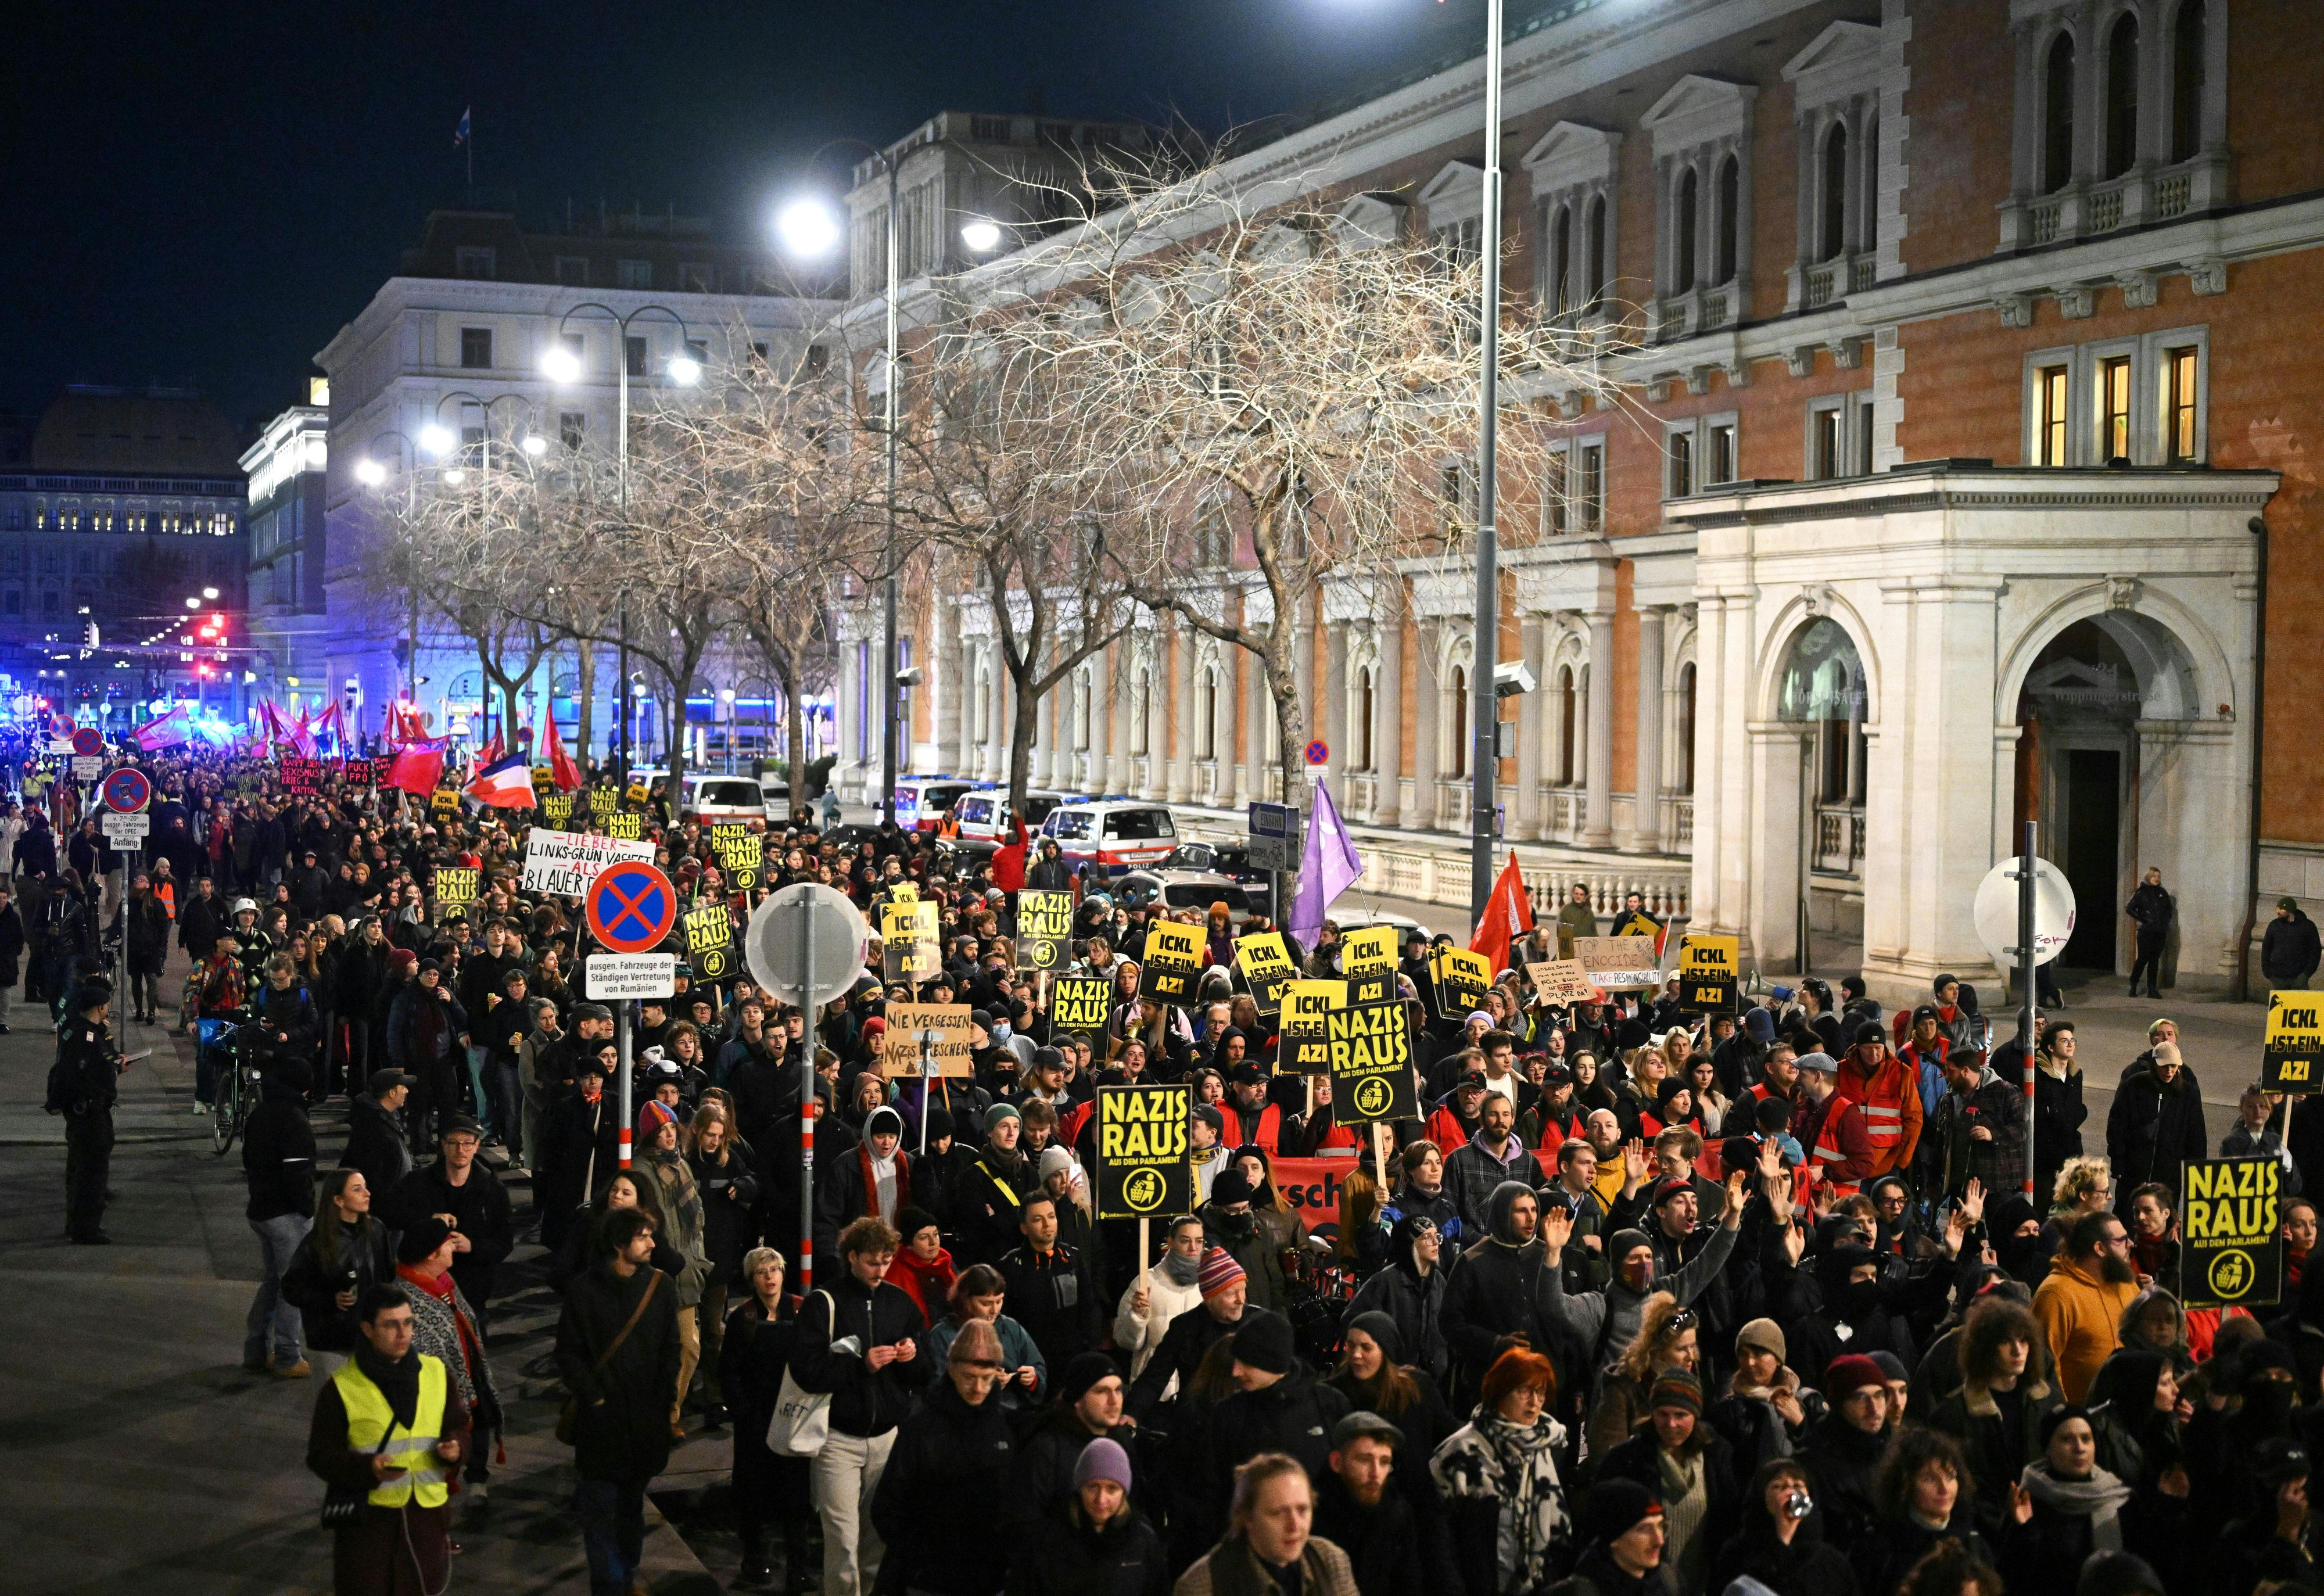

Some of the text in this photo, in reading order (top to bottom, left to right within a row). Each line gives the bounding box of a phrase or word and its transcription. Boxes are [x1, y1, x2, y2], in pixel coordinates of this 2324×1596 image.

[281, 768, 319, 777] SEXISMUS
[349, 763, 368, 772] FUCK
[282, 776, 300, 784] KRIEG
[291, 786, 318, 795] KAPITAL
[591, 790, 617, 801] NAZIS
[545, 795, 572, 806] NAZIS
[590, 801, 616, 812] RAUS
[546, 806, 572, 817] RAUS
[609, 813, 640, 826] NAZIS
[1261, 815, 1282, 829] EINBAHN
[609, 825, 640, 838] RAUS
[712, 825, 745, 837] NAZIS
[568, 833, 616, 851] LIEBER
[725, 836, 760, 853] NAZIS
[530, 842, 602, 863] LINKS-GRÜN
[727, 849, 761, 867] RAUS
[437, 870, 476, 884] NAZIS
[572, 862, 600, 876] ALS
[525, 869, 583, 894] BLAUER
[437, 884, 476, 899] RAUS
[1021, 894, 1071, 913] NAZIS
[685, 905, 727, 931] NAZIS
[895, 915, 928, 931] ICKL
[1020, 912, 1070, 934] RAUS
[688, 921, 730, 950] RAUS
[890, 935, 934, 951] IST EIN
[1159, 934, 1193, 954] ICKL
[710, 941, 729, 951] PARLAMENT
[1249, 945, 1281, 963] ICKL
[1353, 941, 1383, 959] ICKL
[1575, 939, 1598, 956] TOP
[1607, 939, 1630, 952] THE
[901, 955, 927, 971] AZI
[1149, 954, 1195, 974] IST EIN
[1693, 948, 1727, 963] ICKL
[590, 963, 618, 971] ausgen.
[621, 961, 657, 970] Fahrzeuge
[1250, 964, 1292, 982] IST EIN
[1348, 962, 1388, 980] IST EIN
[1452, 957, 1482, 977] ICKL
[591, 973, 670, 982] Ständigen Vertretung
[1448, 974, 1487, 993] IST EIN
[1591, 972, 1613, 983] TAKE
[1685, 968, 1731, 982] IST EIN
[621, 984, 657, 992] Rumänien
[1056, 980, 1110, 1001] NAZIS
[1156, 975, 1184, 994] AZI
[1267, 984, 1283, 1001] AZ
[1359, 982, 1382, 1000] AZI
[1577, 988, 1588, 996] DA!
[1695, 988, 1722, 1003] AZI
[913, 1012, 970, 1028] VERGESSEN
[1054, 1000, 1107, 1023] RAUS
[2282, 1009, 2318, 1028] ICKL
[1287, 1021, 1310, 1036] IST
[1328, 1005, 1404, 1041] NAZIS
[1330, 1032, 1407, 1071] RAUS
[2271, 1035, 2321, 1052] IST EIN
[1297, 1044, 1327, 1062] AZI
[1351, 1069, 1365, 1077] DEM
[1366, 1064, 1403, 1075] PARLAMENT
[2279, 1061, 2310, 1080] AZI
[1103, 1089, 1187, 1122] NAZIS
[1102, 1120, 1187, 1157] RAUS
[1109, 1156, 1180, 1166] AUS DEM PARLAMENT
[2188, 1160, 2279, 1200] NAZIS
[2186, 1195, 2278, 1239] RAUS
[2193, 1235, 2270, 1248] AUS DEM PARLAMENT
